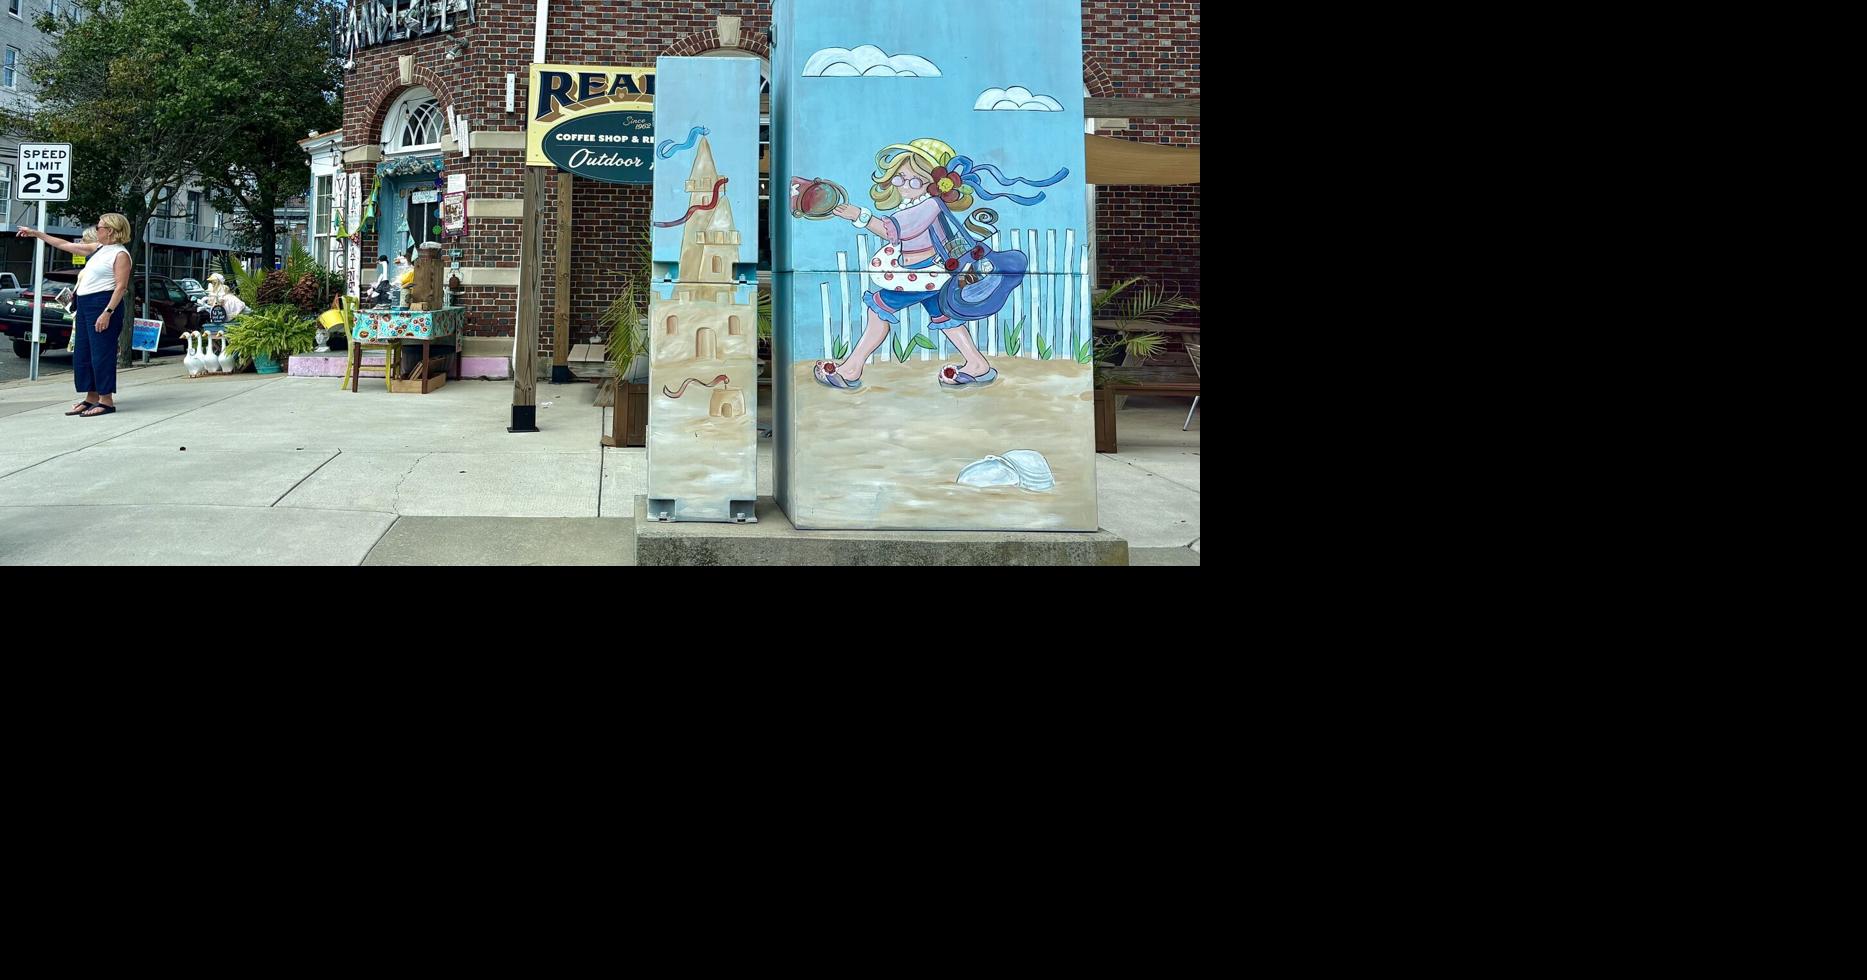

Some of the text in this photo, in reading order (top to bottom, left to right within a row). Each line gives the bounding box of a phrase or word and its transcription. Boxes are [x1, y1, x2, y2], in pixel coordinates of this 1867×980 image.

[623, 116, 645, 126] Since
[556, 134, 596, 142] COFFEE
[598, 135, 629, 143] SHOP
[631, 135, 639, 143] &
[23, 150, 67, 159] SPEED
[568, 148, 644, 169] Outdoor
[27, 161, 62, 170] LIMIT
[22, 172, 65, 194] 25
